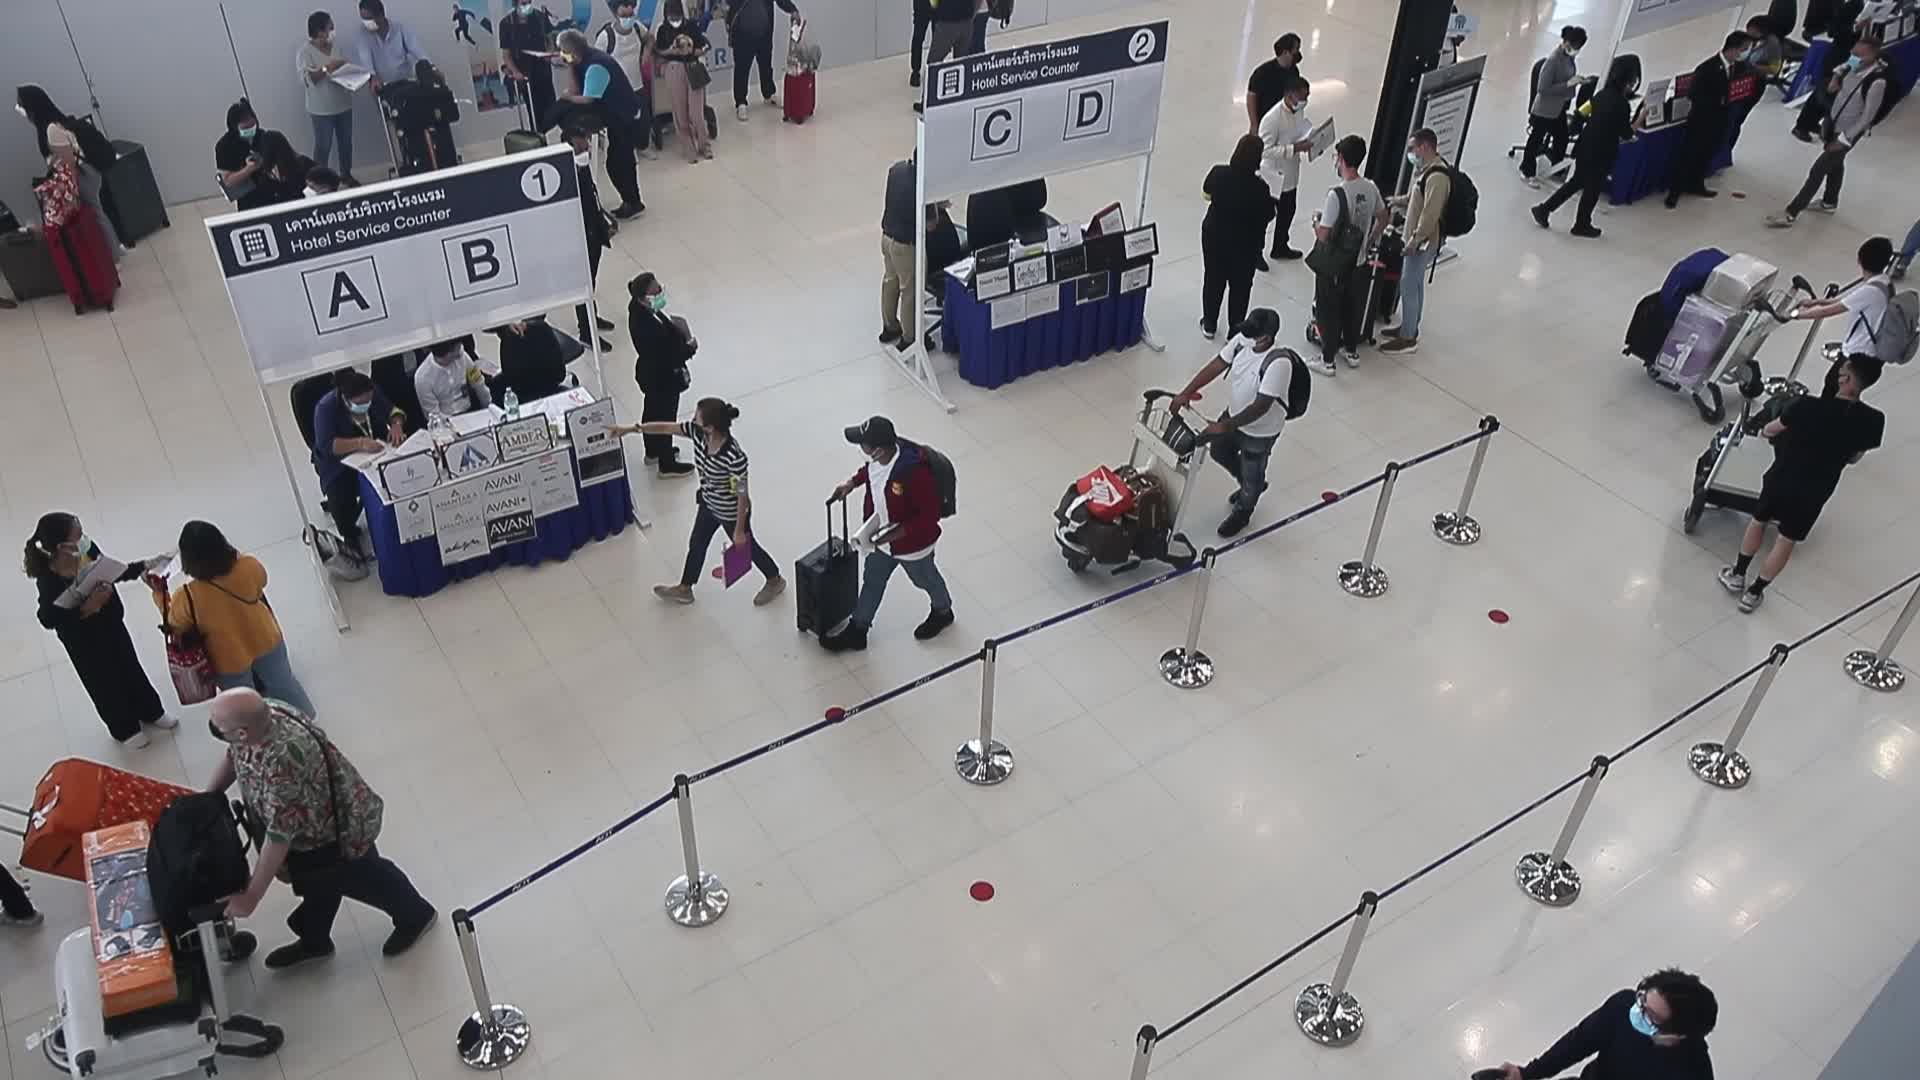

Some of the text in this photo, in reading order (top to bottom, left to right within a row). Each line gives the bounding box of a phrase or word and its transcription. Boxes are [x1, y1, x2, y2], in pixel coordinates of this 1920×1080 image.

[972, 44, 1080, 73] เคาน์เตอร์บริการโรงแรม
[1134, 32, 1149, 58] 2
[971, 61, 1080, 91] Hotel Service Counter
[1076, 90, 1104, 128] D
[982, 108, 1012, 147] C
[531, 168, 547, 197] 1
[285, 188, 445, 233] เคาน์เตอร์บริการโรงแรม
[290, 208, 451, 253] Hotel Service Counter
[461, 238, 500, 284] B
[328, 271, 370, 319] A
[501, 428, 548, 449] AMBER
[484, 471, 521, 491] AVANI
[490, 514, 534, 537] AVANI
